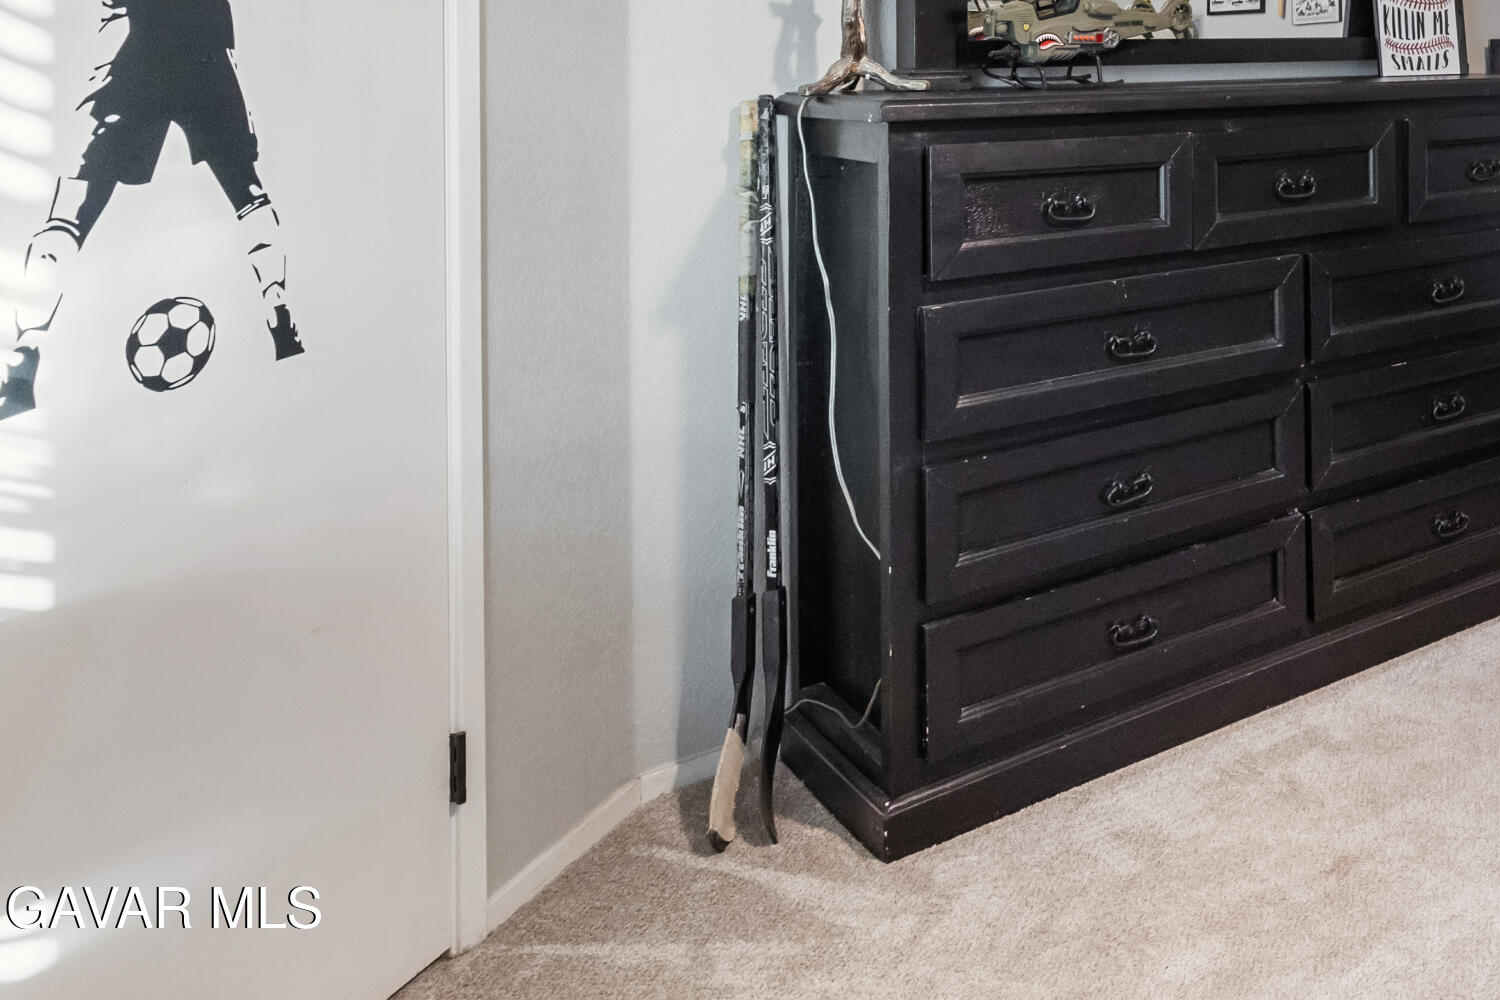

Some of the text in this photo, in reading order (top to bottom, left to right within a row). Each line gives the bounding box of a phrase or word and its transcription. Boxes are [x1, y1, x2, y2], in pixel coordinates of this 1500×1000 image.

[1383, 4, 1450, 41] KILLIN ME
[1391, 49, 1450, 72] SMALLS
[767, 529, 777, 578] Franklin
